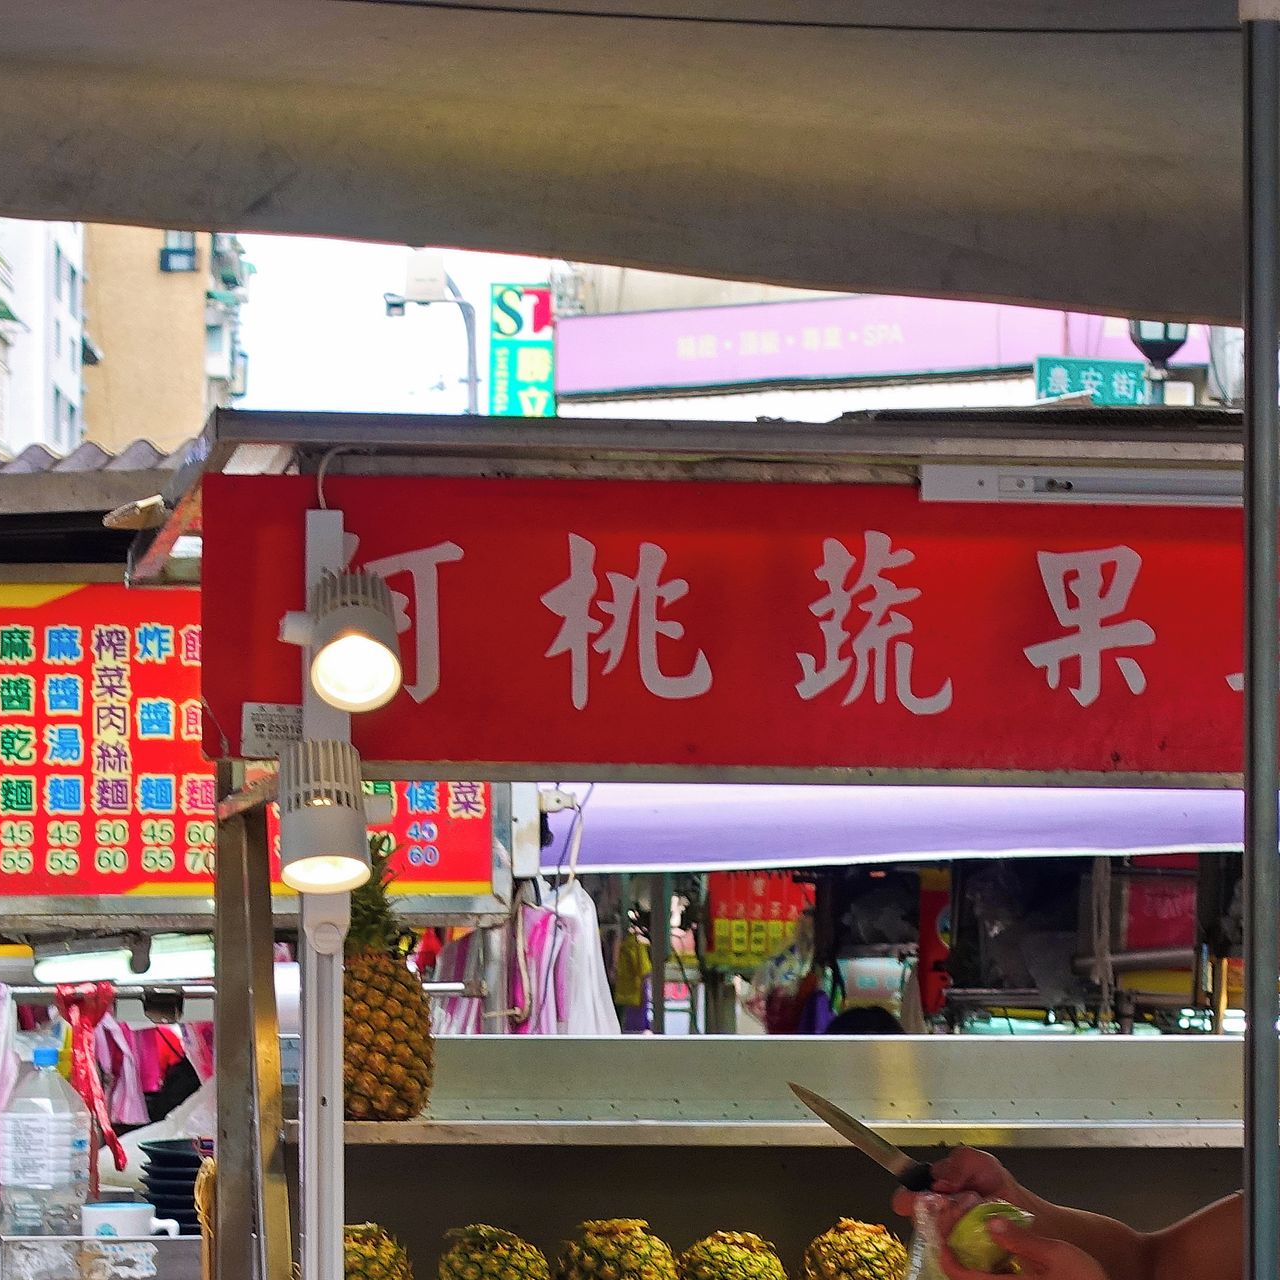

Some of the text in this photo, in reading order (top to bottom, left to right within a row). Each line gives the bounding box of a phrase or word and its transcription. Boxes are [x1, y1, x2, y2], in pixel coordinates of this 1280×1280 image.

[42, 624, 84, 816] 麻醬湯麵
[91, 624, 132, 815] 榨菜肉絲麵
[135, 622, 176, 815] 炸醬麵
[0, 821, 34, 847] 45
[47, 821, 81, 847] 45
[95, 821, 129, 847] 50
[139, 821, 175, 847] 45
[0, 848, 33, 874] 55
[47, 848, 81, 874] 55
[95, 848, 129, 874] 60
[141, 848, 175, 873] 55
